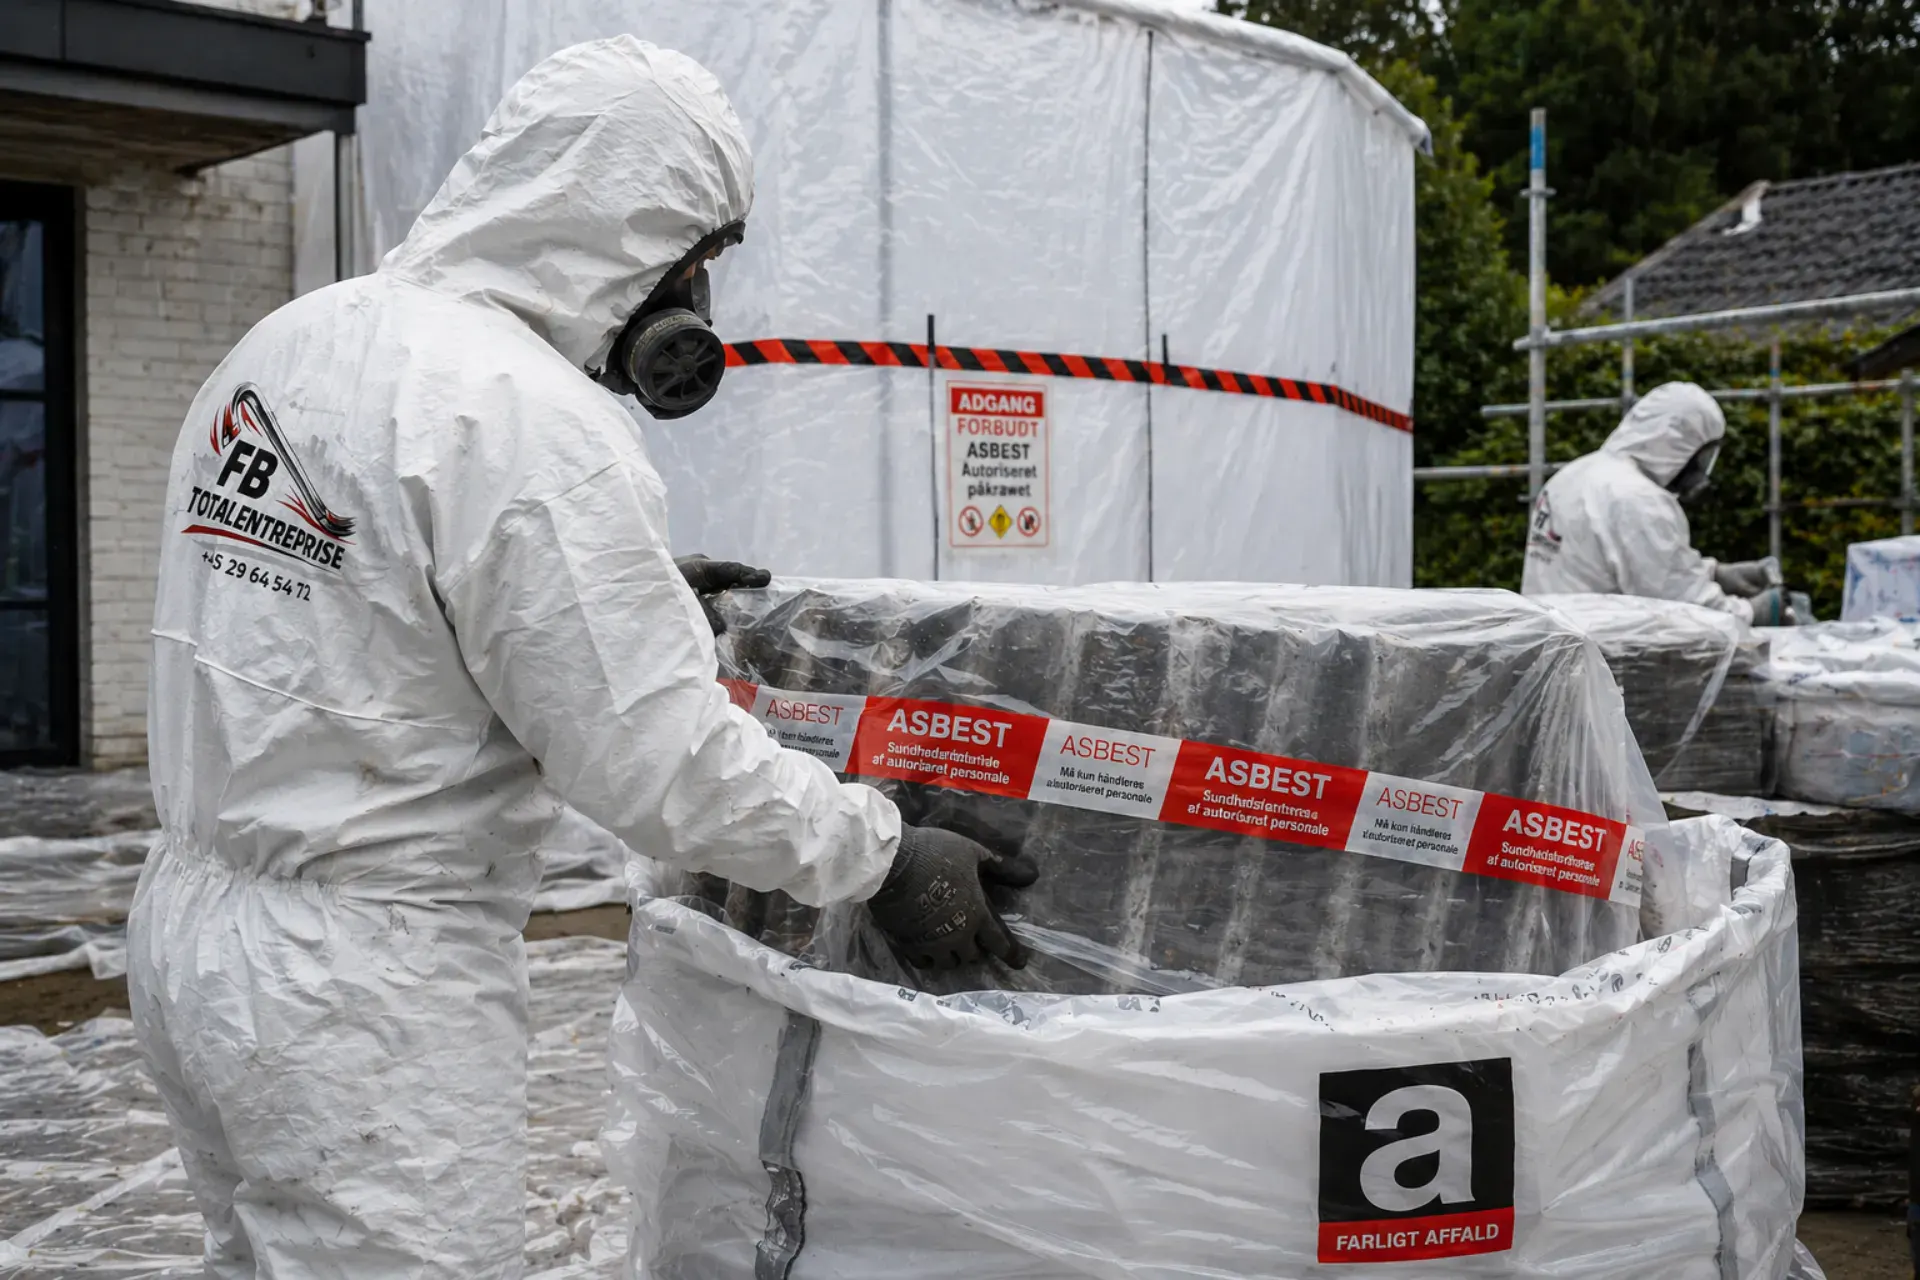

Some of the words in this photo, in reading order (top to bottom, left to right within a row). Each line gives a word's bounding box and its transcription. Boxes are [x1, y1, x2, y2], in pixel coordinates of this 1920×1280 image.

[958, 392, 1036, 414] ADGANG
[957, 417, 1039, 438] FORBUDT
[967, 441, 1031, 460] ASBEST
[216, 439, 279, 500] FB
[962, 461, 1038, 479] Autoriseret
[187, 485, 346, 570] TOTALENTREPRISE
[225, 558, 247, 579] 29
[249, 566, 270, 588] 64
[271, 575, 293, 596] 54
[296, 581, 311, 602] 72
[765, 698, 845, 726] ASBEST
[886, 707, 1012, 748] ASBEST
[1059, 734, 1156, 769] ASBEST
[1203, 755, 1332, 800] ASBEST
[1376, 786, 1464, 820] ASBEST
[1502, 808, 1608, 853] ASBEST
[1486, 853, 1499, 866] af
[1359, 1083, 1476, 1213] a
[1336, 1230, 1420, 1251] FARLIGT
[1424, 1222, 1500, 1246] AFFALD
